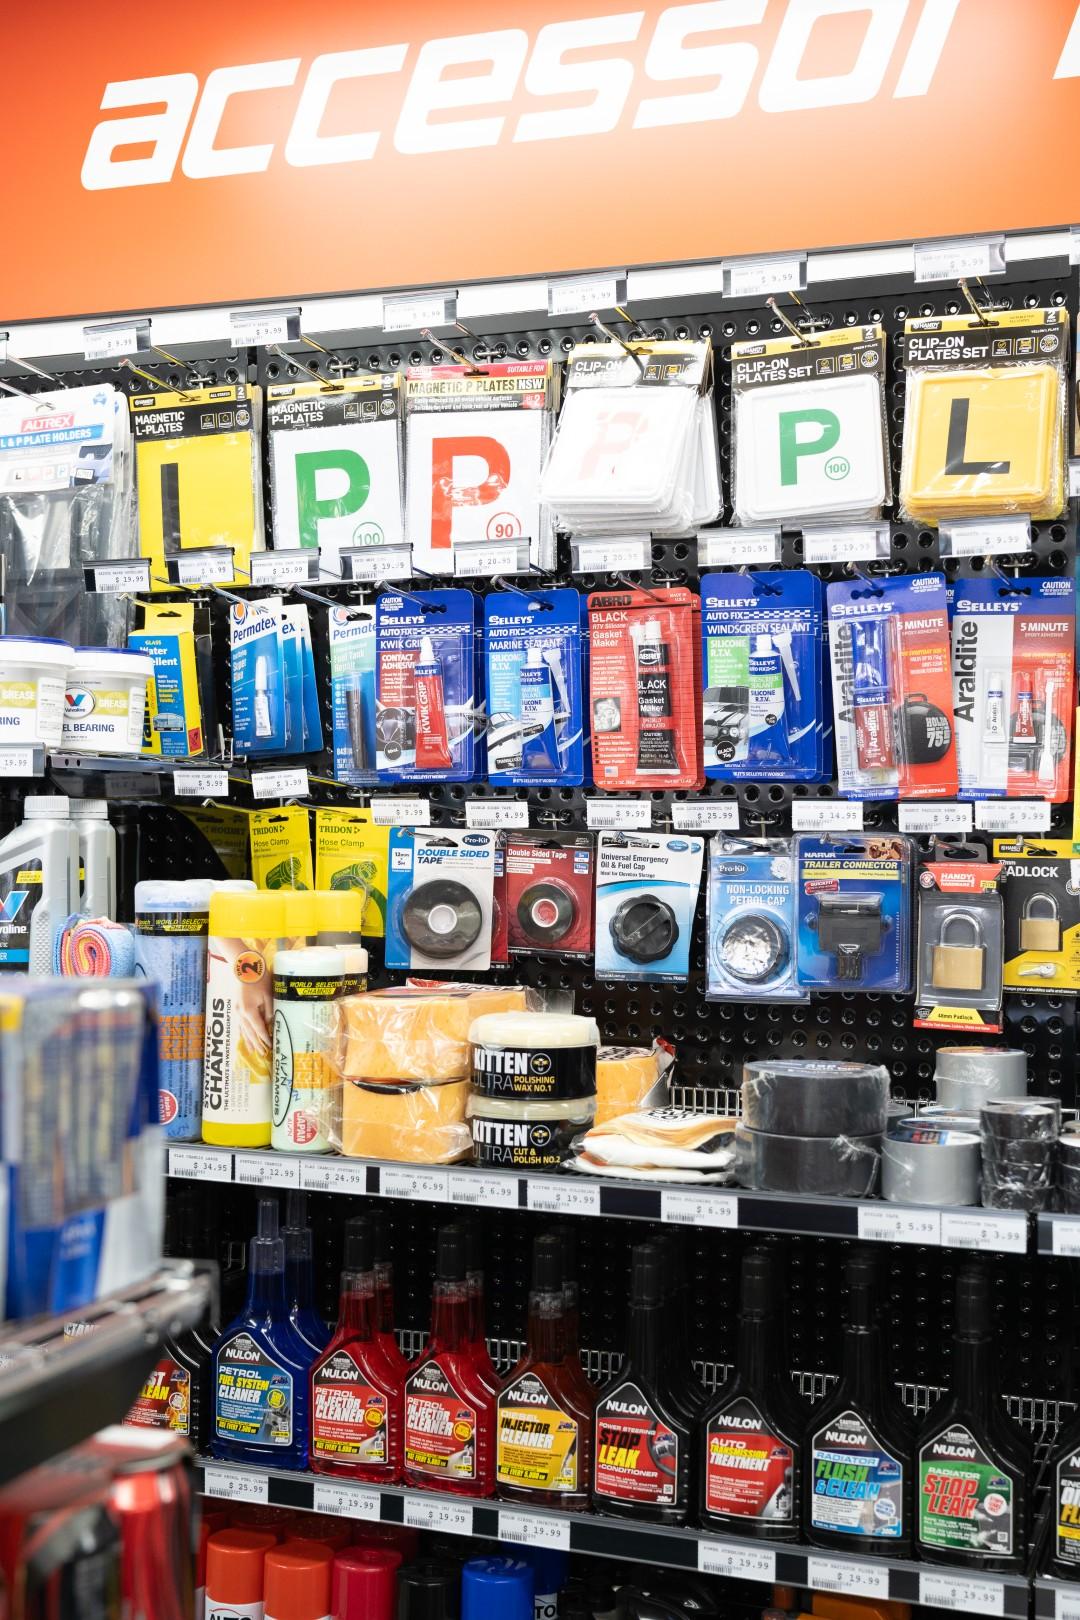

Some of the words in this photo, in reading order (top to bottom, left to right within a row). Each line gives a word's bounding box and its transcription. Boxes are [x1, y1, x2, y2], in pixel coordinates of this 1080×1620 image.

[909, 337, 964, 349] CLIP-ON
[909, 348, 959, 361] PLATES
[962, 346, 988, 359] SET
[507, 366, 532, 374] SUITABLE
[736, 358, 789, 373] CLIP-ON
[737, 370, 790, 384] PLATES
[792, 366, 812, 378] SET
[409, 381, 463, 394] MAGNETIC
[476, 379, 515, 391] PLATES
[518, 378, 543, 389] NSW
[272, 401, 325, 414] MAGNETIC
[23, 415, 71, 432] ALTREX
[135, 411, 185, 425] MAGNETIC
[272, 412, 323, 425] P-PLATES
[135, 422, 183, 436] L-PLATES
[24, 433, 51, 445] PLATE
[53, 429, 92, 442] HOLDERS
[945, 398, 1010, 475] L
[779, 409, 840, 486] P
[828, 462, 847, 474] 100
[431, 436, 510, 549] P
[496, 523, 513, 537] 90
[357, 532, 380, 545] 100
[912, 577, 939, 586] CAUTION
[706, 598, 759, 607] SELLEYS
[831, 602, 894, 616] SELLEYS
[957, 600, 1022, 612] SELLEYS
[380, 615, 426, 625] SELLEYS
[489, 615, 534, 625] SELLEYS
[592, 612, 628, 622] BLACK
[707, 612, 729, 620] AUTO
[233, 616, 277, 643] Permatex
[707, 623, 768, 634] WINDSCREEN
[770, 622, 811, 632] SEALANT
[593, 631, 622, 639] Gasket
[490, 641, 522, 650] MARINE
[524, 639, 560, 648] SEALANT
[711, 639, 747, 648] SILICONE
[954, 621, 978, 722] Araldite
[637, 680, 666, 689] BLACK
[74, 724, 114, 732] BEARING
[253, 827, 279, 835] TRIDON
[319, 826, 352, 834] TRIDON
[270, 838, 289, 846] Clamp
[341, 839, 364, 848] Clamp
[464, 836, 488, 844] Pro-Kit
[417, 849, 459, 857] DOUBLE
[508, 849, 529, 857] Double
[530, 850, 550, 858] Sided
[552, 850, 567, 859] Tape
[601, 853, 631, 861] Universal
[632, 855, 668, 864] Emergency
[632, 863, 646, 871] Cap
[719, 864, 746, 873] Pro-Kit
[804, 861, 841, 869] TRAILER
[843, 861, 897, 869] CONNECTOR
[1006, 867, 1059, 877] ADLOCK
[726, 885, 789, 895] NON-LOCKING
[730, 896, 764, 905] PETROL
[767, 896, 785, 905] CAP
[210, 998, 224, 1110] CHAMOIS
[203, 1026, 212, 1108] SYNTHETIC
[474, 1049, 528, 1075] KITTEN
[473, 1073, 513, 1091] ULTRA
[514, 1075, 555, 1085] POLISHING
[514, 1083, 532, 1092] WAX
[533, 1084, 551, 1092] NO.1
[473, 1120, 527, 1147] KITTEN
[473, 1145, 513, 1163] ULTRA
[514, 1148, 528, 1156] CUT
[514, 1154, 541, 1163] POLISH
[542, 1155, 561, 1164] NO.2
[203, 1164, 228, 1172] 34.95
[994, 1231, 1019, 1240] 3.99
[226, 1348, 260, 1361] NULON
[219, 1366, 261, 1379] PETROL
[321, 1368, 358, 1380] NULON
[219, 1374, 233, 1386] FUEL
[236, 1376, 269, 1391] SYSTEM
[413, 1378, 448, 1392] NULON
[219, 1386, 261, 1403] CLEANER
[316, 1387, 355, 1398] PETROL
[508, 1391, 548, 1405] NULON
[316, 1394, 361, 1409] INJECTOR
[408, 1397, 444, 1410] PETROL
[606, 1400, 647, 1415] NULON
[316, 1405, 365, 1423] CLEANER
[408, 1404, 450, 1420] INJECTOR
[407, 1414, 454, 1436] CLEANER
[501, 1418, 550, 1434] INJECTOR
[718, 1415, 762, 1430] NULON
[501, 1429, 554, 1449] CLEANER
[599, 1428, 641, 1450] STOP
[711, 1437, 746, 1448] AUTO
[825, 1431, 867, 1445] NULON
[599, 1444, 640, 1469] LEAK
[711, 1444, 767, 1459] TRANSMISSION
[933, 1444, 975, 1458] NULON
[710, 1453, 771, 1471] TREATMENT
[817, 1452, 876, 1464] RADIATOR
[816, 1461, 869, 1481] FLUSH
[928, 1467, 980, 1479] RADIATOR
[924, 1474, 978, 1497] STOP
[928, 1495, 979, 1519] LEAK
[739, 1558, 769, 1570] 19.99
